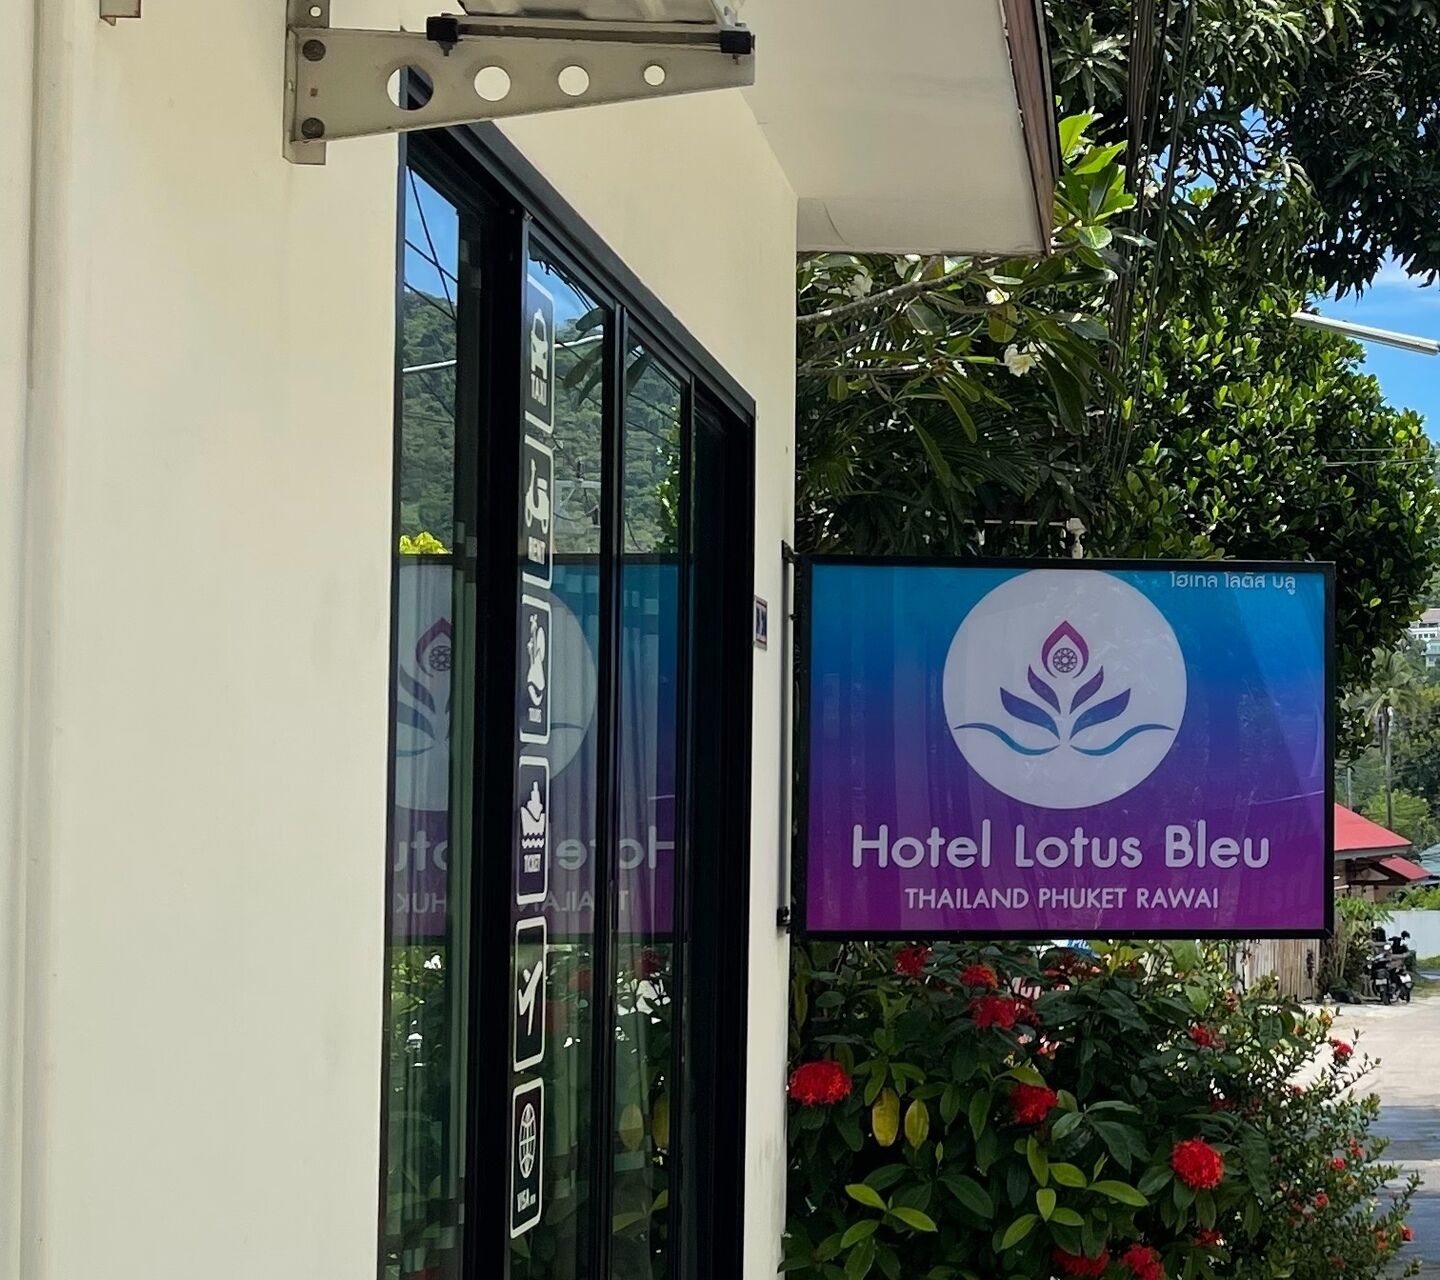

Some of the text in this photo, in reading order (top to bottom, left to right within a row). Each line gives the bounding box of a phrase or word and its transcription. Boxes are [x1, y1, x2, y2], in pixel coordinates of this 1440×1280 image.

[852, 818, 1270, 869] Hotel Lotus Bleu
[904, 887, 1219, 910] THAILAND PHUKET RAWAI
